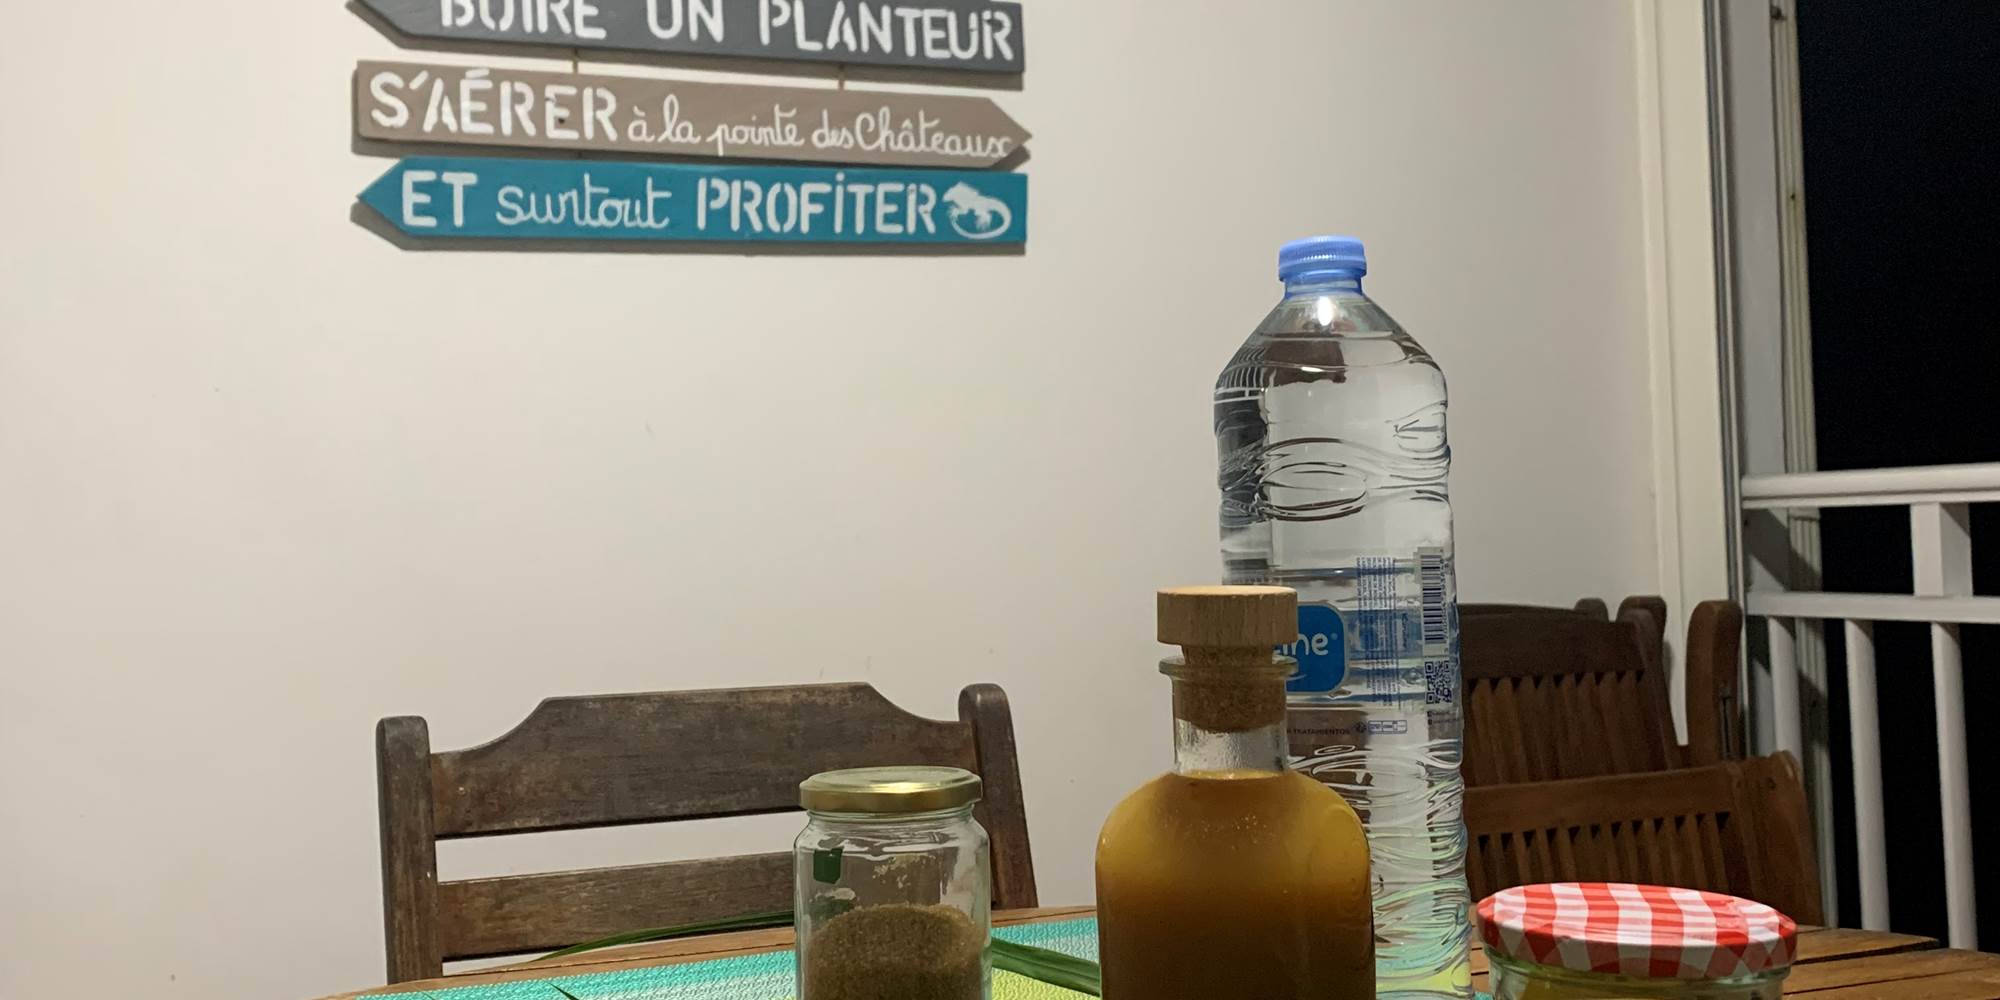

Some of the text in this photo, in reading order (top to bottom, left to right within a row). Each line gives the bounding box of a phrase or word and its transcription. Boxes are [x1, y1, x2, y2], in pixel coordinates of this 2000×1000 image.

[646, 0, 724, 43] UN
[758, 0, 1014, 61] PLANTEUR
[627, 105, 654, 142] à
[658, 94, 701, 144] la
[706, 103, 804, 156] pointe
[811, 108, 853, 150] des
[854, 105, 1014, 158] Châteaux
[402, 170, 478, 227] ET
[495, 172, 673, 229] surtout
